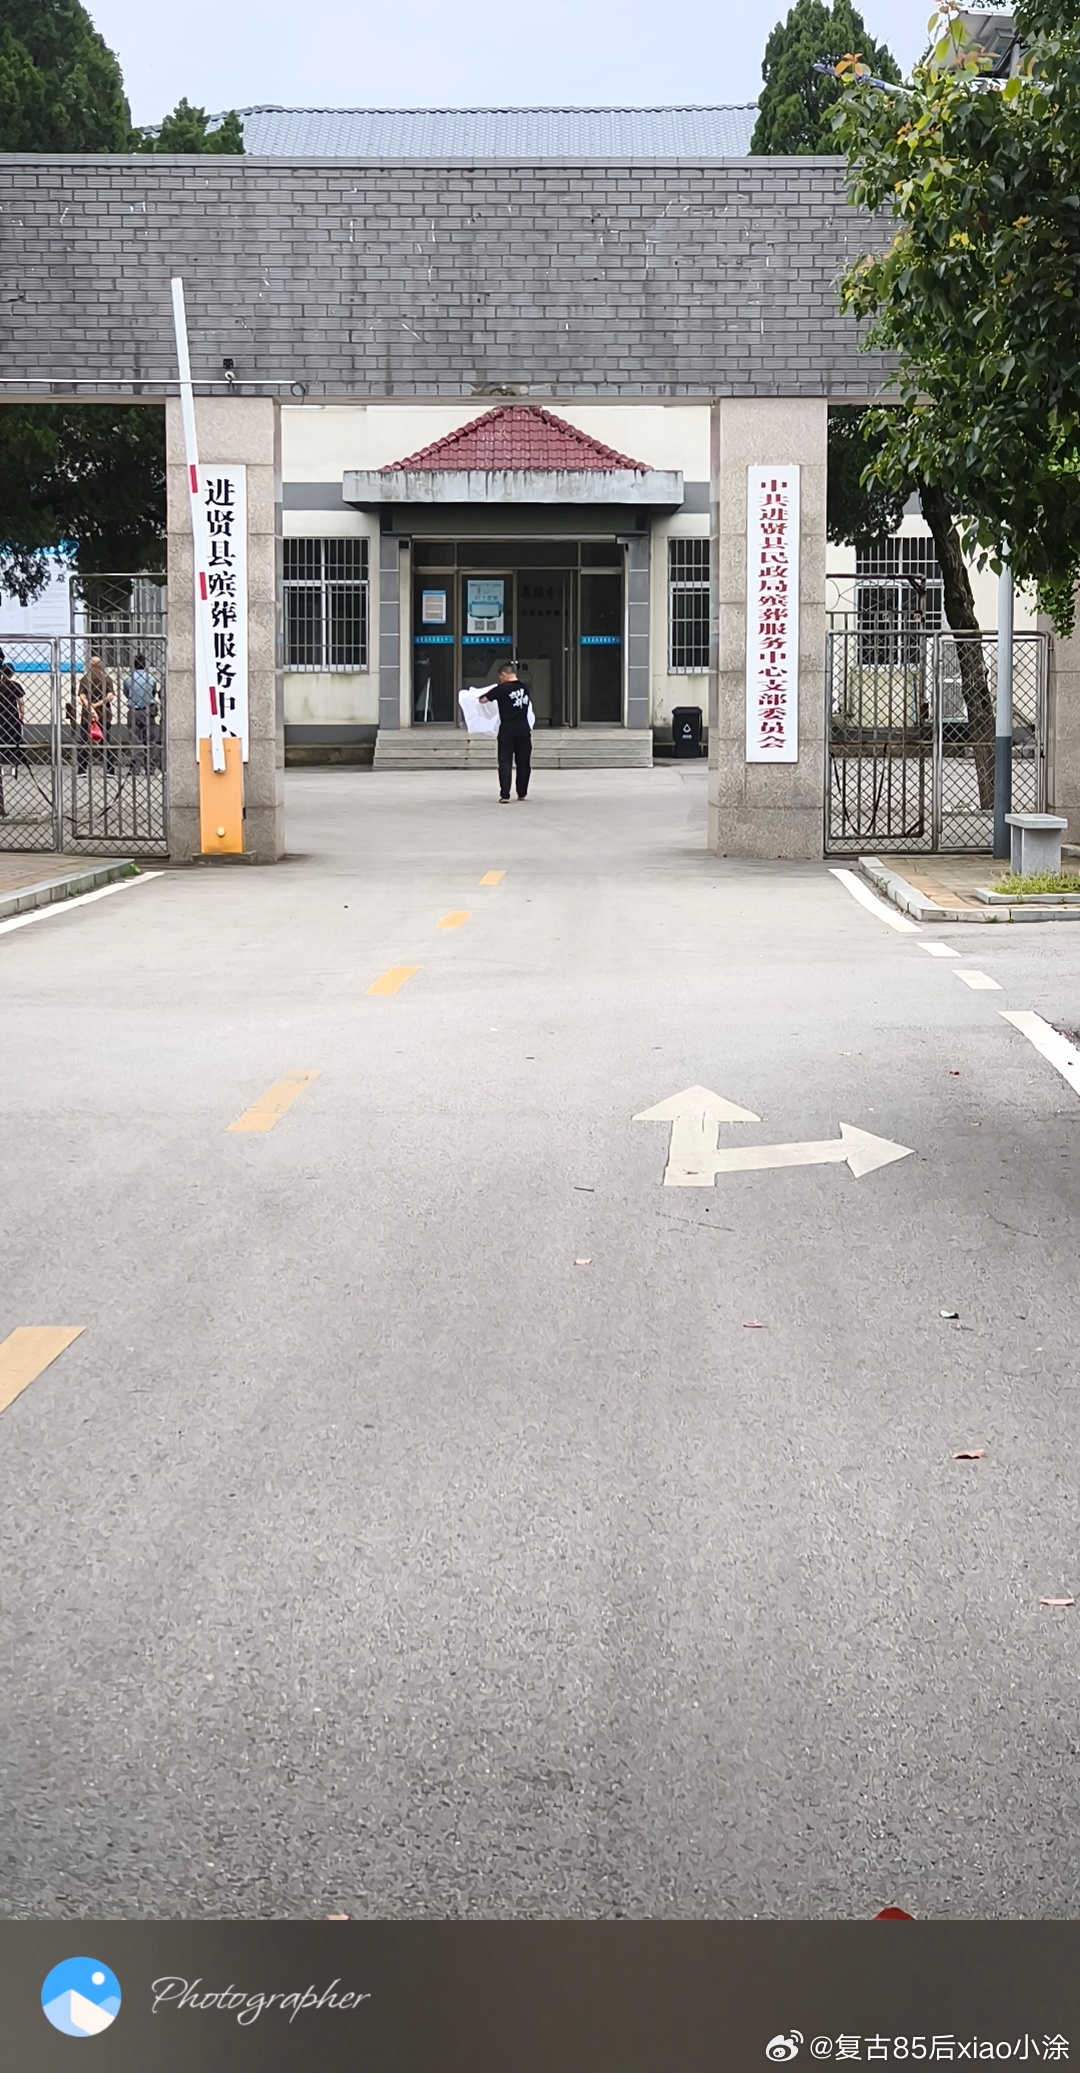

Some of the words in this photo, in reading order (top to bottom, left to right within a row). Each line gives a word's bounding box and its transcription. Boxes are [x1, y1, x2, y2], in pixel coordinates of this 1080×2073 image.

[204, 478, 238, 738] 进贤县殡葬服务中
[757, 479, 789, 750] 中共进贤县民政局殡葬服务中心支部委员会
